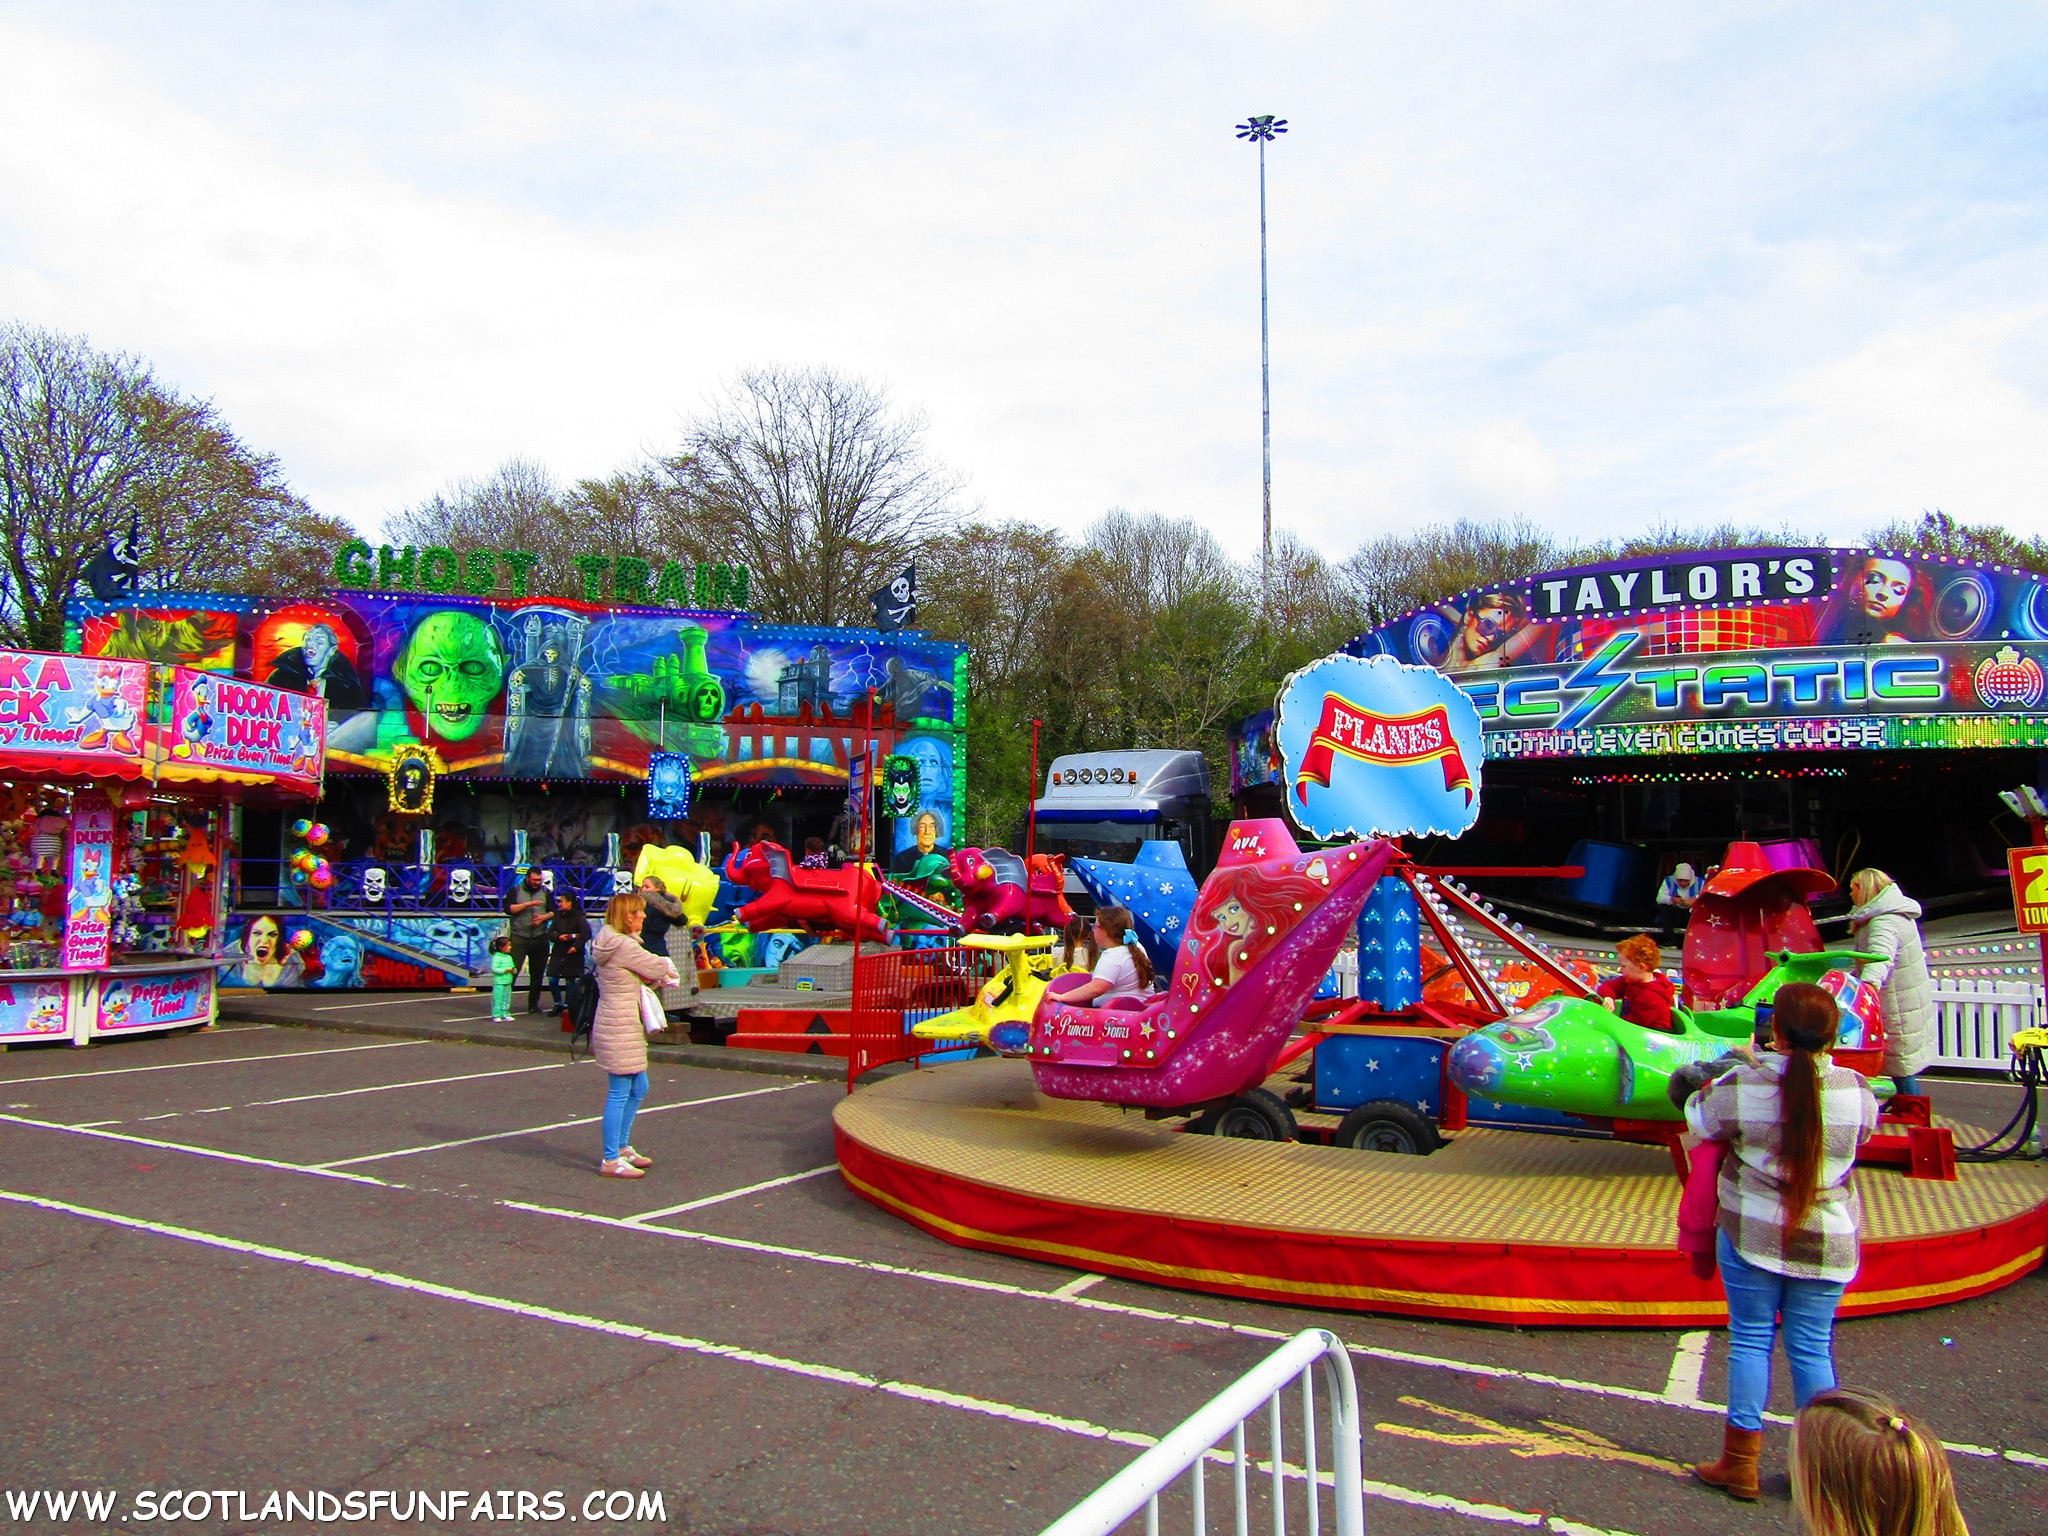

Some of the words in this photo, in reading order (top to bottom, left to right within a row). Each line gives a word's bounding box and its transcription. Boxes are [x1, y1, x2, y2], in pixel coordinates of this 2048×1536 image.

[335, 540, 540, 598] GHOST
[572, 554, 751, 608] TRAIN
[1542, 558, 1815, 614] TAYLOR'S
[35, 658, 73, 690] A
[217, 683, 275, 719] HOOK
[276, 693, 293, 722] A
[22, 723, 86, 744] Time!
[226, 715, 282, 750] DUCK
[1330, 707, 1443, 755] PLANES
[1491, 733, 1595, 753] NOTHING
[1600, 732, 1672, 749] EVEN
[1678, 728, 1778, 746] COMES
[1783, 725, 1883, 744] CLOSE
[203, 742, 235, 761] Prize
[237, 746, 267, 766] Every
[268, 748, 296, 766] Time!
[89, 814, 100, 828] A
[75, 830, 113, 844] DUCK
[1232, 835, 1259, 850] AVA
[70, 921, 105, 934] Prize
[68, 935, 106, 949] Every
[68, 949, 106, 961] Time!
[131, 983, 169, 1004] Prize
[151, 996, 186, 1017] Time!
[1057, 1013, 1095, 1037] Princess
